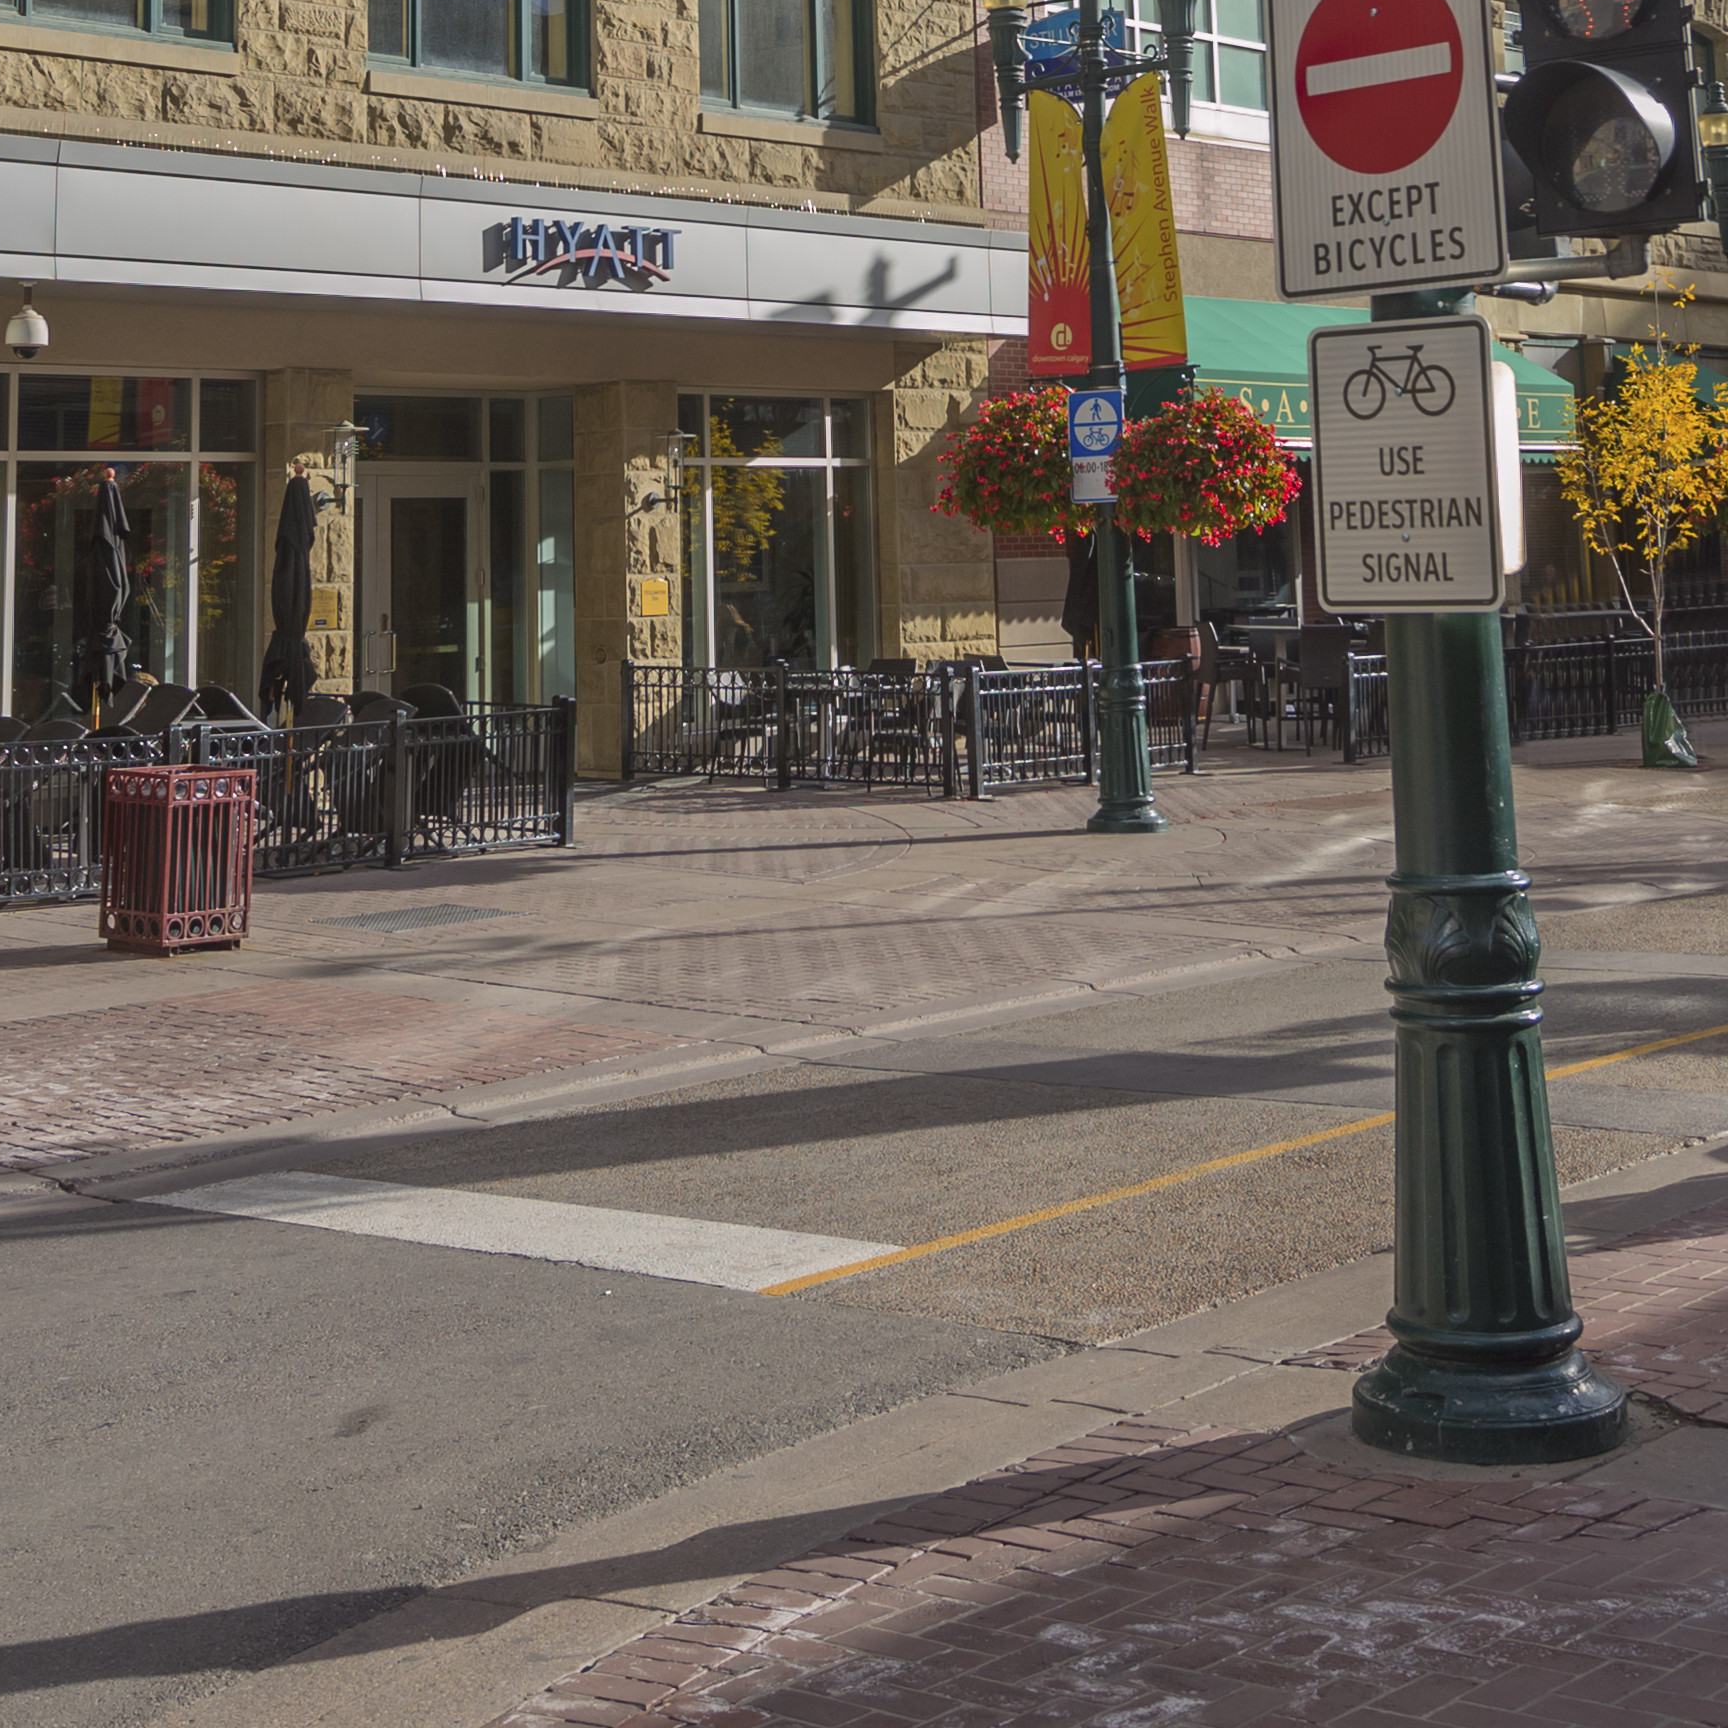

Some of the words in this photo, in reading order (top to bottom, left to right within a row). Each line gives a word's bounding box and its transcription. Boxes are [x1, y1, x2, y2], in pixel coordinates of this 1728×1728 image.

[1140, 85, 1159, 135] Walk
[1148, 138, 1168, 211] Avenue
[1331, 181, 1440, 228] EXCEPT
[510, 216, 683, 279] HYATT
[1158, 218, 1177, 303] Stephen
[1314, 225, 1466, 275] BICYCLES
[1379, 445, 1425, 476] USE
[1329, 496, 1483, 531] PEDESTRIAN
[1362, 552, 1454, 584] SIGNAL
